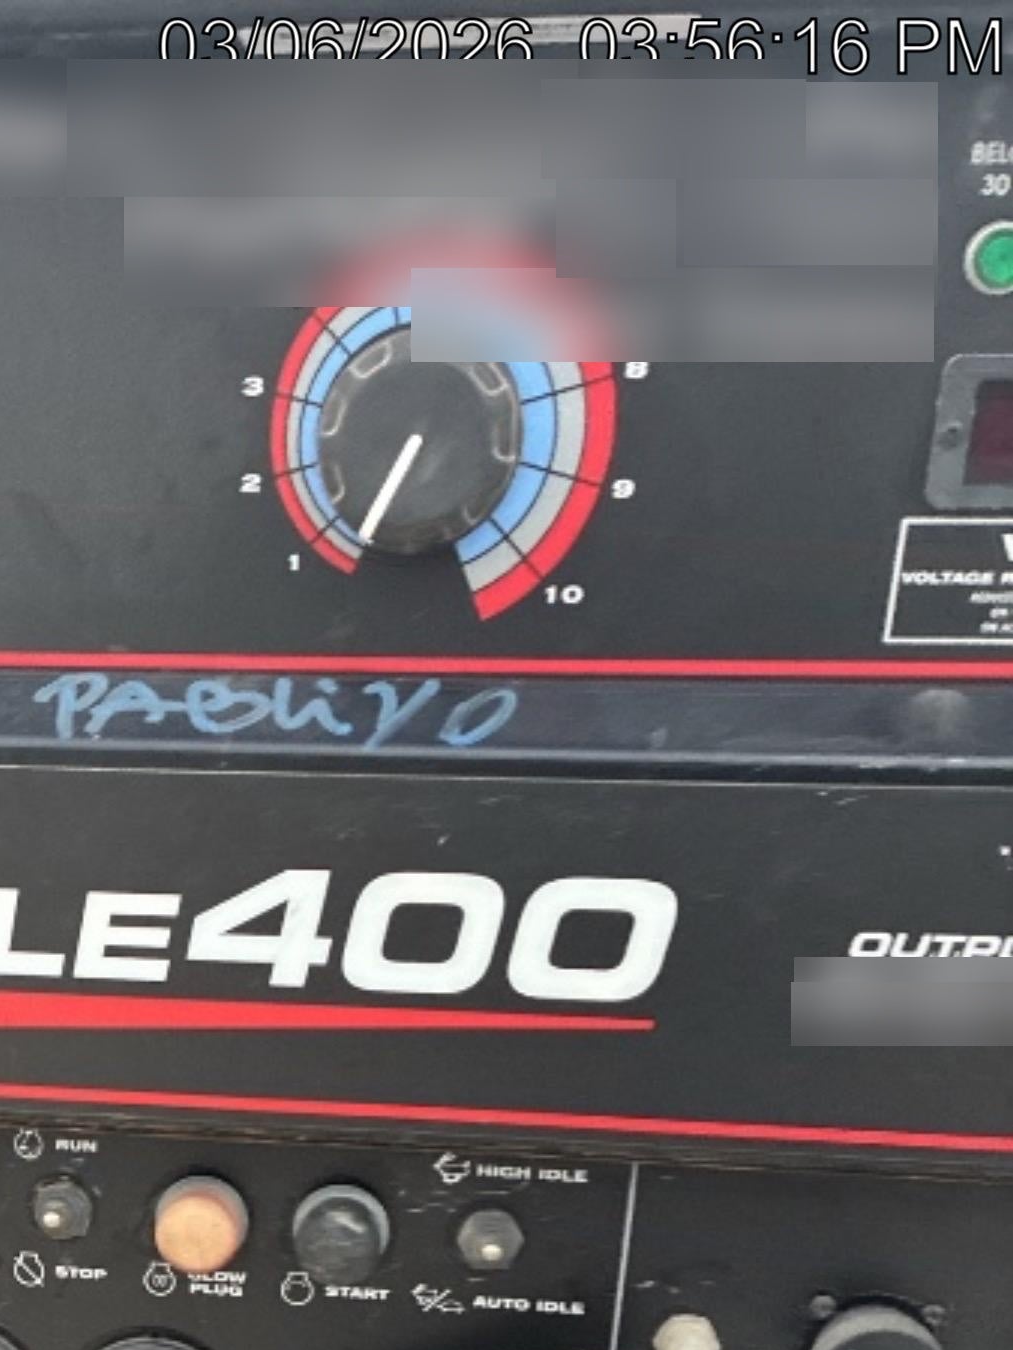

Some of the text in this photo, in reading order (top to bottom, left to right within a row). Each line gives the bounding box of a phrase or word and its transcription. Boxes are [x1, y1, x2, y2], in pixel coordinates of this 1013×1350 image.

[971, 140, 1013, 165] BEL
[243, 377, 265, 398] 3
[240, 472, 262, 494] 2
[611, 478, 636, 500] 9
[288, 553, 300, 572] 1
[543, 585, 584, 606] 10
[55, 1138, 97, 1153] RUN
[475, 1164, 588, 1184] HIGH IDLE
[55, 1265, 107, 1281] STOP
[190, 1283, 243, 1298] PLUG
[324, 1285, 390, 1301] START
[472, 1295, 585, 1316] AUTO IDLE
